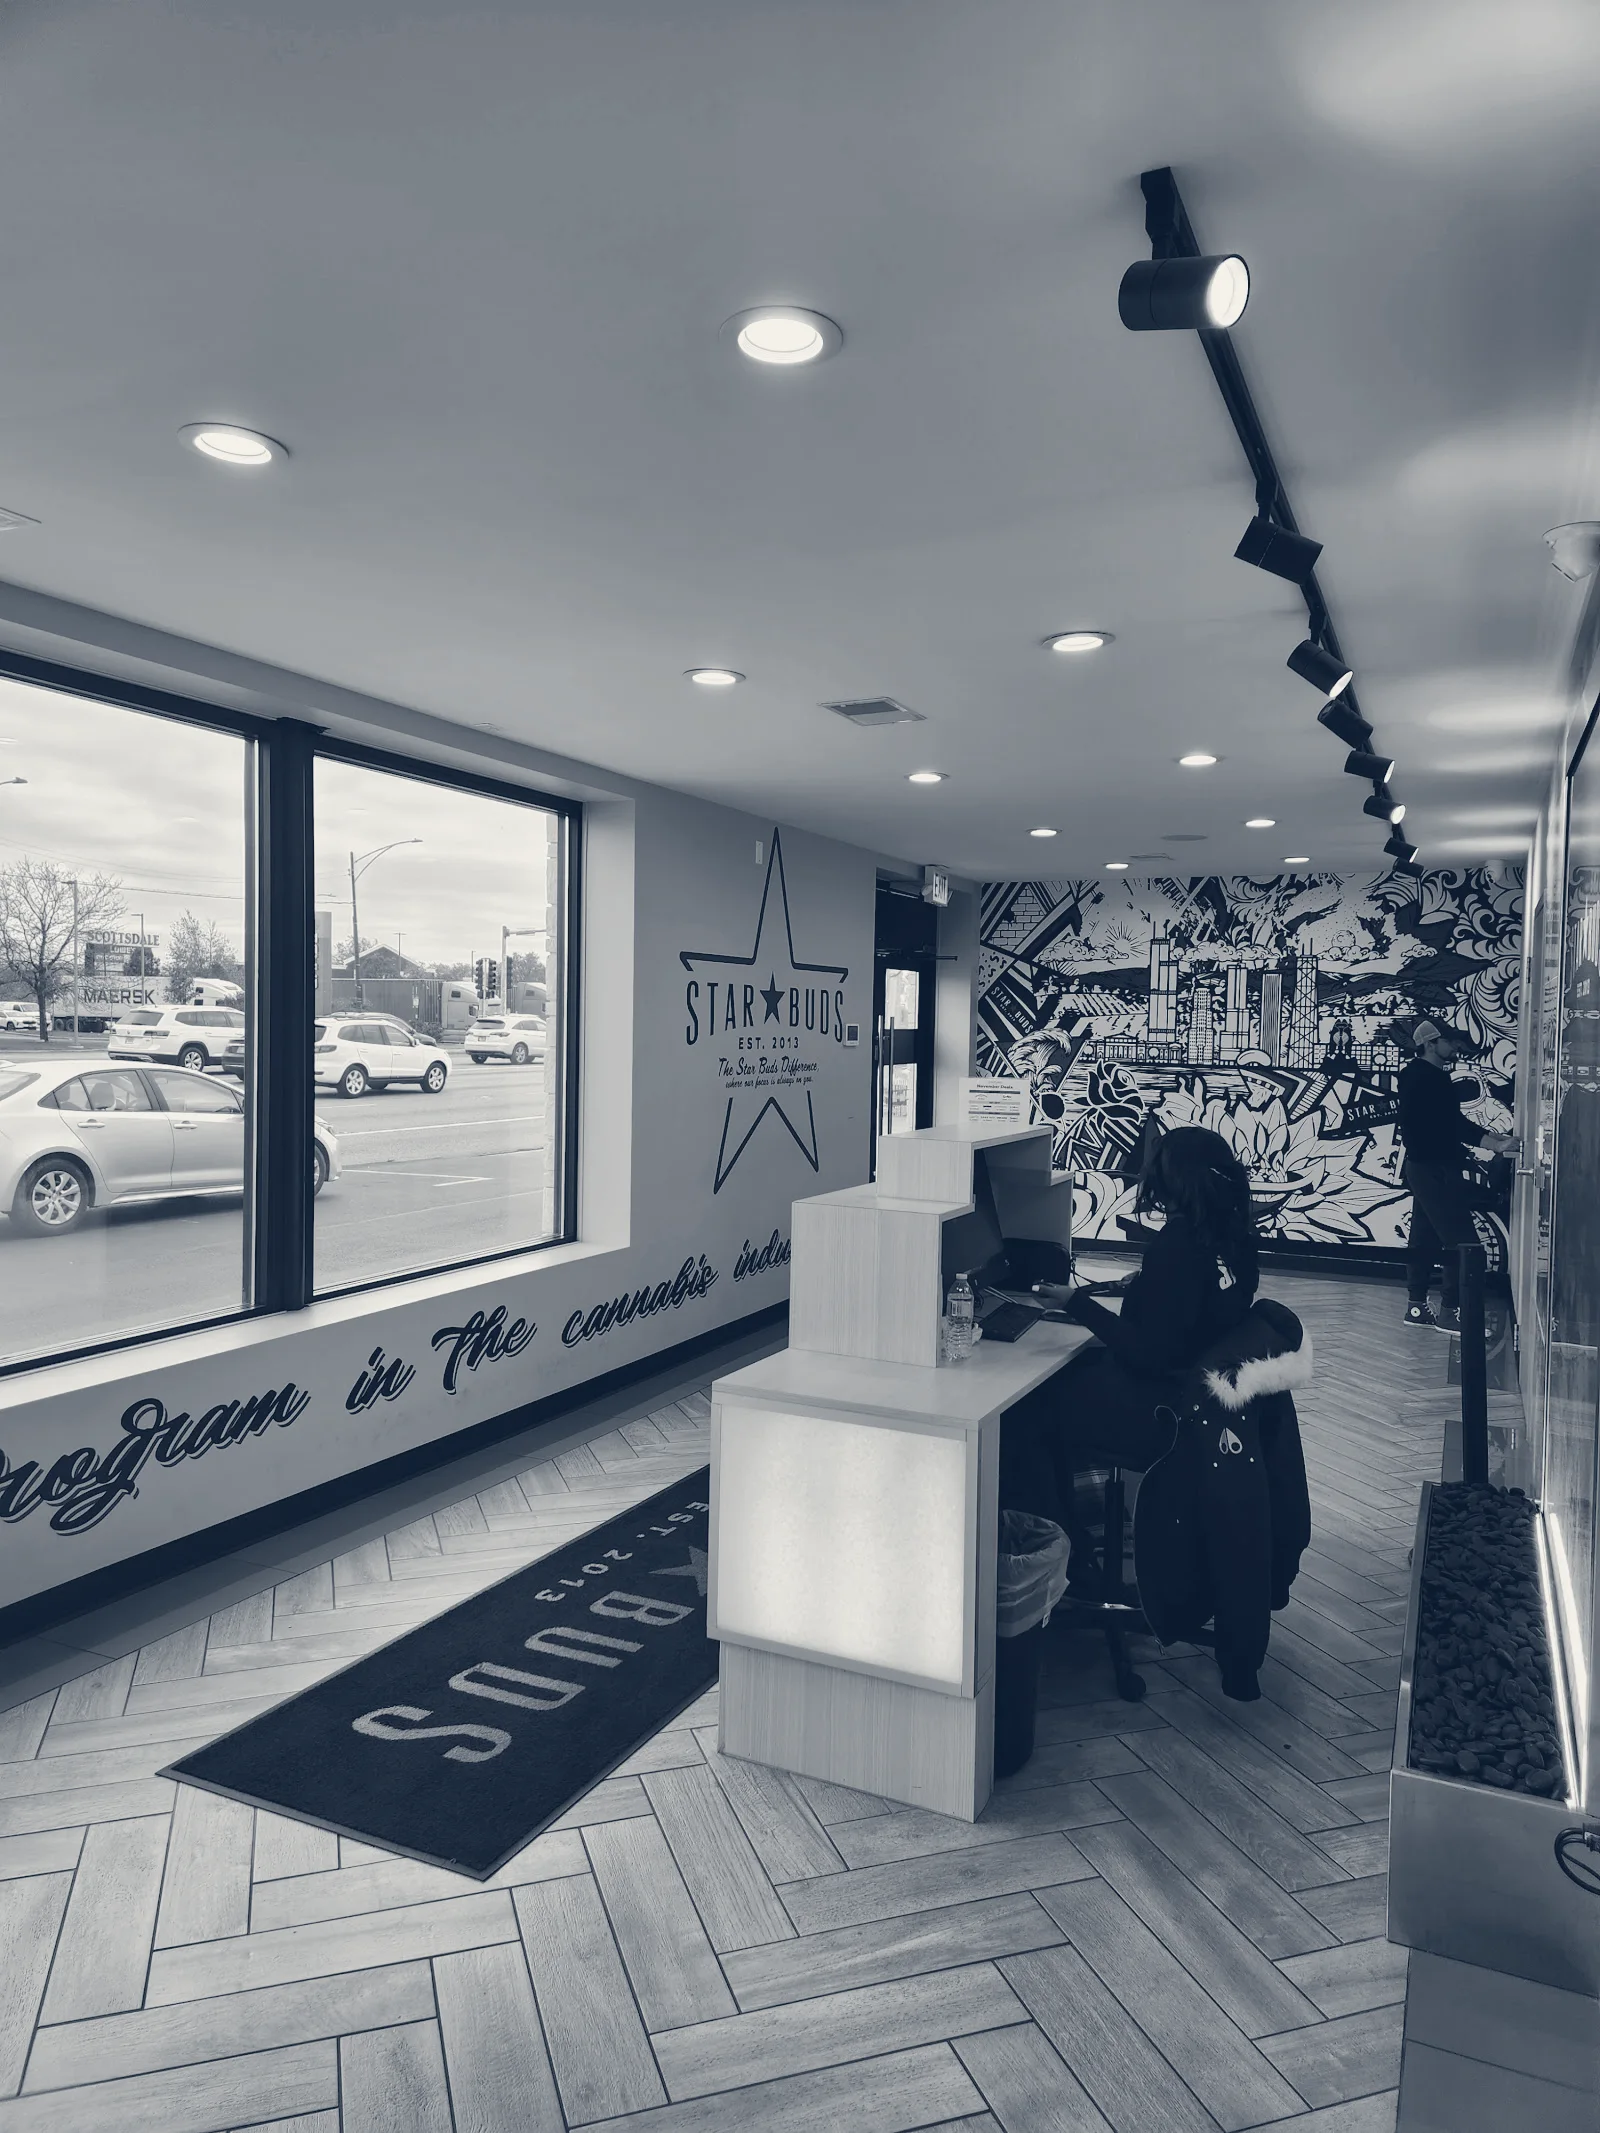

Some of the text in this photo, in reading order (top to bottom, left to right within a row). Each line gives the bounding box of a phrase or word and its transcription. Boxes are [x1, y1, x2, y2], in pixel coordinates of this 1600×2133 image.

[934, 873, 947, 900] EXIT
[87, 929, 160, 946] SCOTTSDALE
[84, 989, 155, 1005] MAERSK
[686, 980, 843, 1046] STAR BUDS
[991, 986, 1034, 1034] STAR BUDS
[738, 1036, 799, 1050] EST. 2013
[718, 1057, 734, 1077] The
[736, 1056, 756, 1076] Star
[758, 1056, 778, 1074] Buds
[725, 1077, 743, 1089] where
[754, 1076, 769, 1089] focus
[770, 1078, 775, 1086] is
[777, 1075, 795, 1087] always
[1346, 1104, 1376, 1122] STAR
[0, 1383, 312, 1537] rogram
[345, 1346, 416, 1415] in
[561, 1254, 720, 1348] cannabis
[534, 1547, 633, 1603] 2013
[352, 1590, 695, 1763] BUDS
